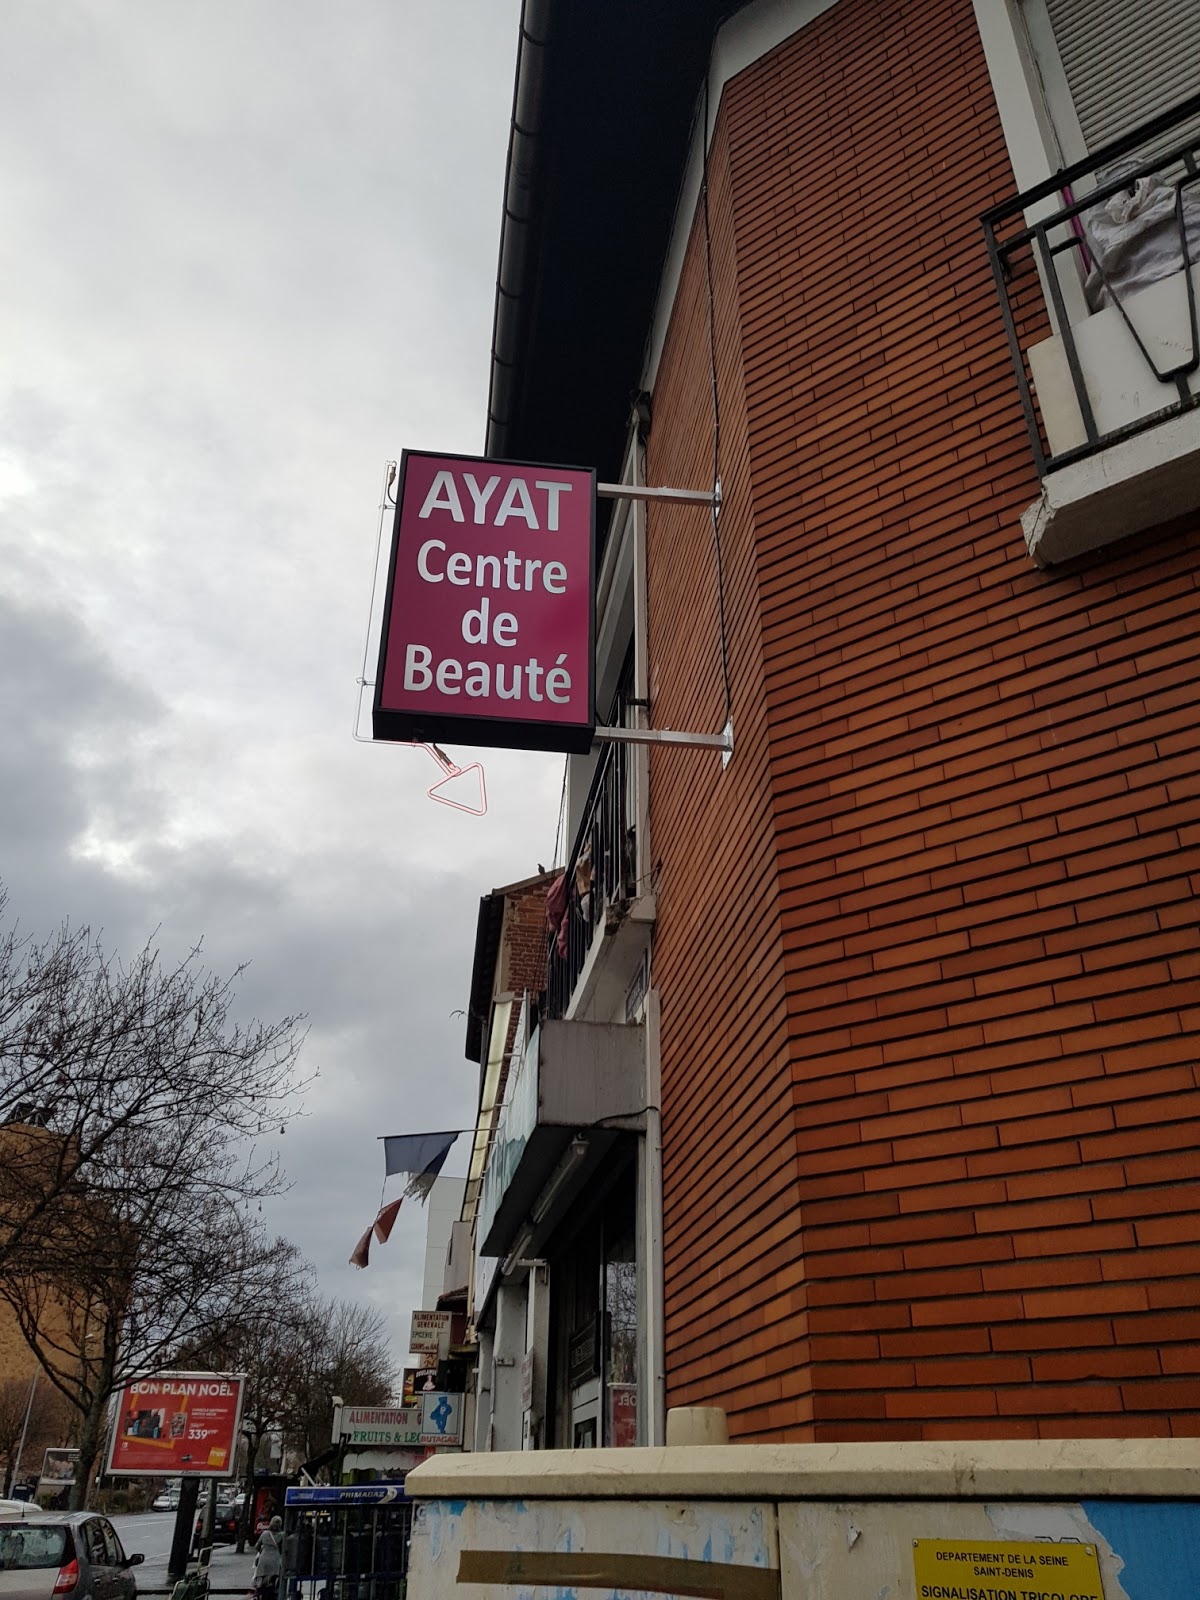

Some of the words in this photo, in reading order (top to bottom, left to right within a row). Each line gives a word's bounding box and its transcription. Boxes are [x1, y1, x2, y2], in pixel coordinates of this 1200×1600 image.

[419, 470, 573, 531] AYAT
[416, 539, 568, 594] Centre
[461, 597, 519, 647] de
[403, 644, 572, 704] Beauté
[413, 1313, 449, 1321] ALIMENTATION
[130, 1382, 159, 1394] BON
[162, 1383, 195, 1395] PLAN
[199, 1382, 233, 1397] NOËL
[349, 1410, 408, 1424] ALIMENTATION
[187, 1429, 208, 1440] 339
[353, 1431, 391, 1442] FRUITS
[394, 1432, 401, 1442] &
[420, 1435, 458, 1443] BUTAGAZ
[936, 1551, 1005, 1563] DEPARTEMENT
[1008, 1554, 1021, 1564] DE
[1024, 1555, 1037, 1565] LA
[1039, 1556, 1069, 1566] SEINE
[973, 1566, 1034, 1578] SAINT-DENIS
[921, 1585, 1016, 1600] SIGNALISATION
